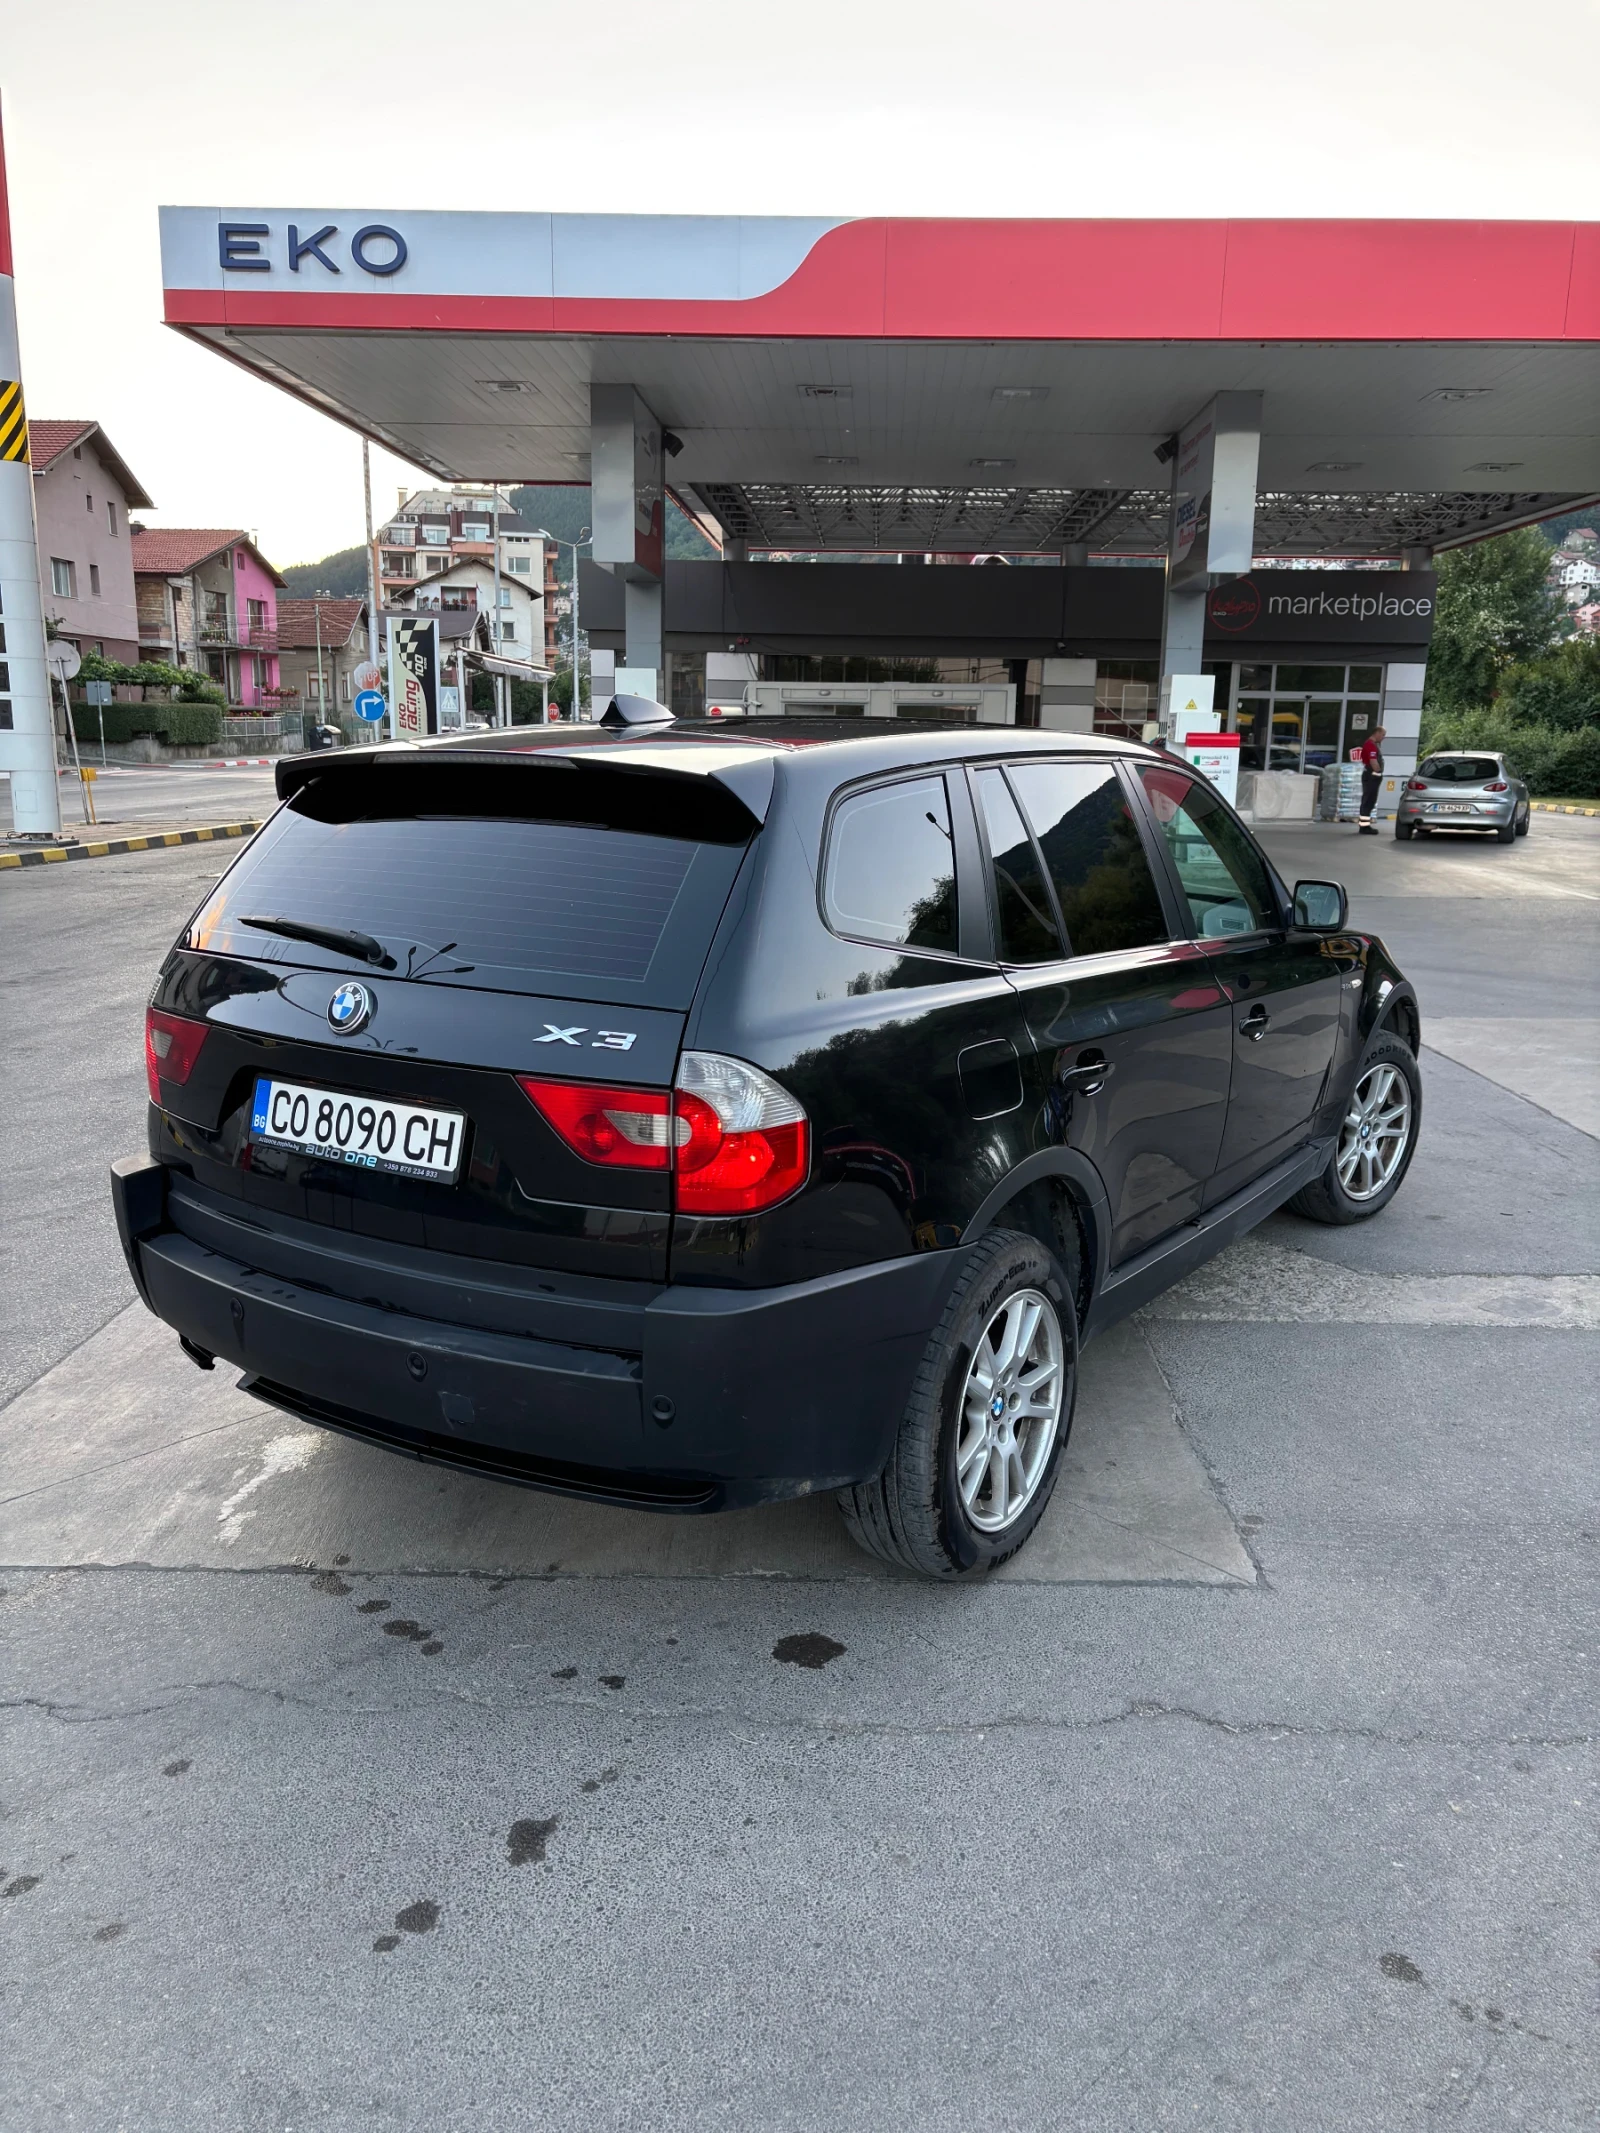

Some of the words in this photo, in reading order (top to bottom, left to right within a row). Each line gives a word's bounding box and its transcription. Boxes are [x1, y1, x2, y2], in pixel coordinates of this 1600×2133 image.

[218, 223, 408, 274] EKO
[1268, 591, 1432, 621] marketplace
[415, 653, 425, 677] 100
[398, 702, 407, 729] EKO
[406, 679, 420, 732] racing
[532, 1023, 638, 1051] X3
[253, 1114, 266, 1129] BG
[315, 1099, 396, 1154] 8090
[403, 1115, 456, 1167] CH
[305, 1144, 341, 1160] auto
[344, 1152, 378, 1167] one
[383, 1162, 399, 1172] +359
[412, 1168, 425, 1176] 234
